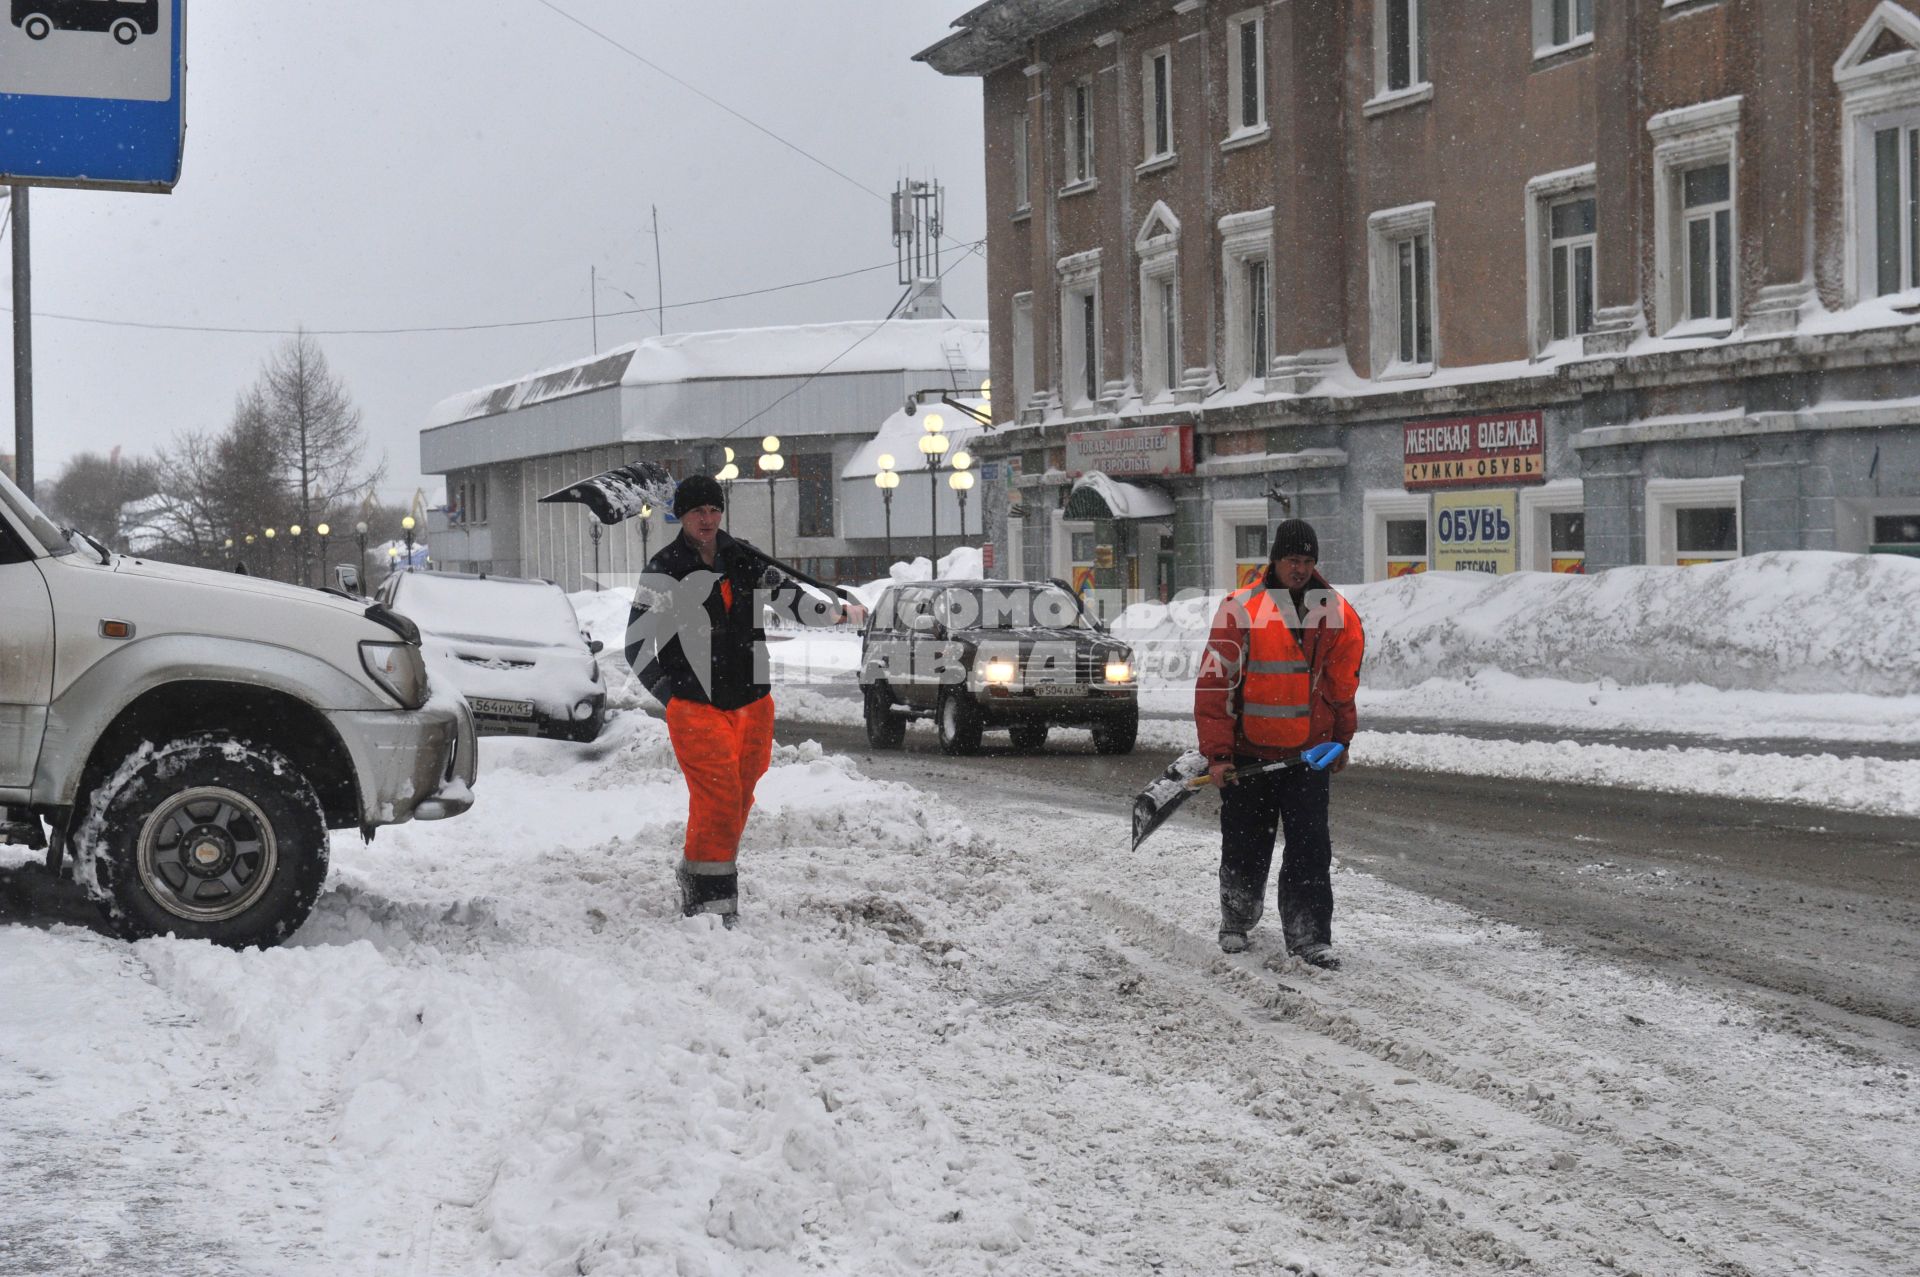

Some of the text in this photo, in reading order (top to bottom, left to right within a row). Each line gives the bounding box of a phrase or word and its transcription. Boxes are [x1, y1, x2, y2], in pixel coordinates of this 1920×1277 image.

[1079, 434, 1167, 455] ТОВАРЫ ДЛЯ ДЕТЕЙ
[1405, 418, 1538, 454] ЖЕНСКАЯ ОДЕЖДА
[1101, 457, 1151, 472] ВЗРОСЛЫХ
[1411, 457, 1533, 479] СУМКИ ОБУВЬ
[1438, 507, 1511, 542] ОБУВЬ
